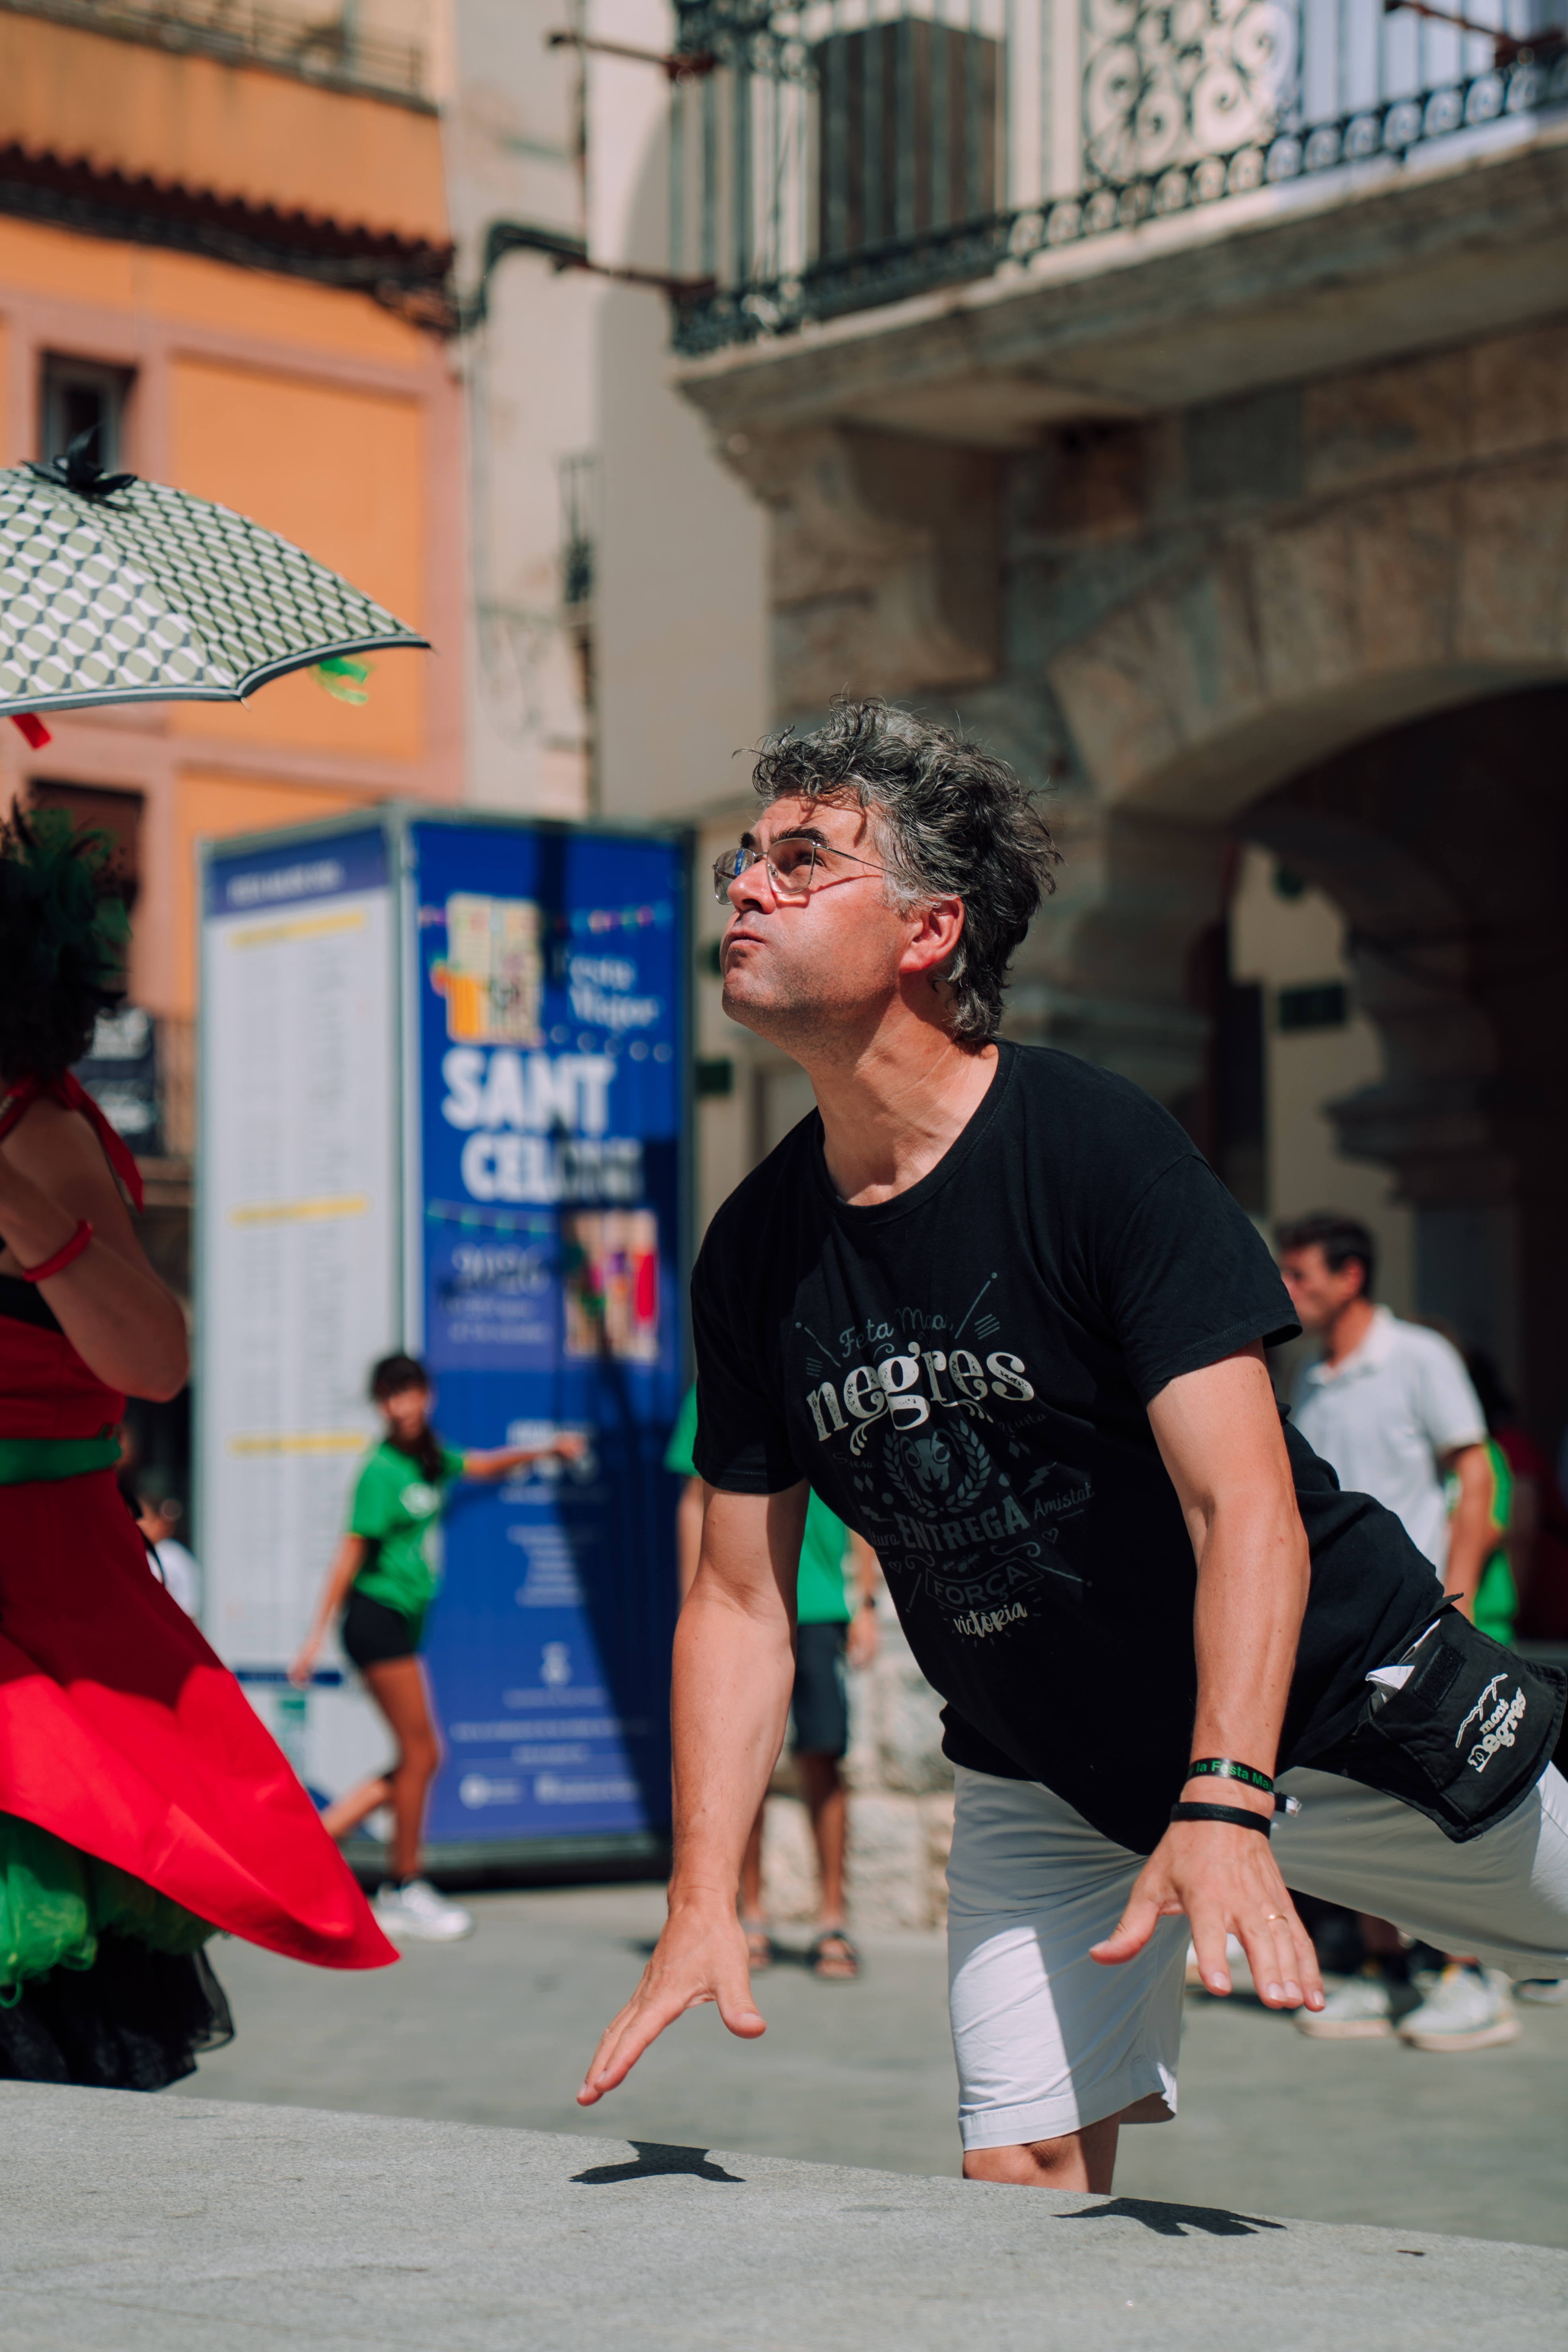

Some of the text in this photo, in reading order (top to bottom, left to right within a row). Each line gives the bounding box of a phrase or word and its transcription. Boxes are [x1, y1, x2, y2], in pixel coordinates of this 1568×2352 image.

[840, 1319, 894, 1358] Feta
[806, 1342, 1035, 1442] negres
[1033, 1481, 1095, 1520] Amistat
[893, 1495, 1031, 1551] ENTREGA
[933, 1565, 1029, 1606] FORÇA
[1466, 1686, 1526, 1773] negres
[1479, 1698, 1509, 1736] mont
[1196, 1762, 1207, 1773] la
[1211, 1760, 1249, 1780] Festa
